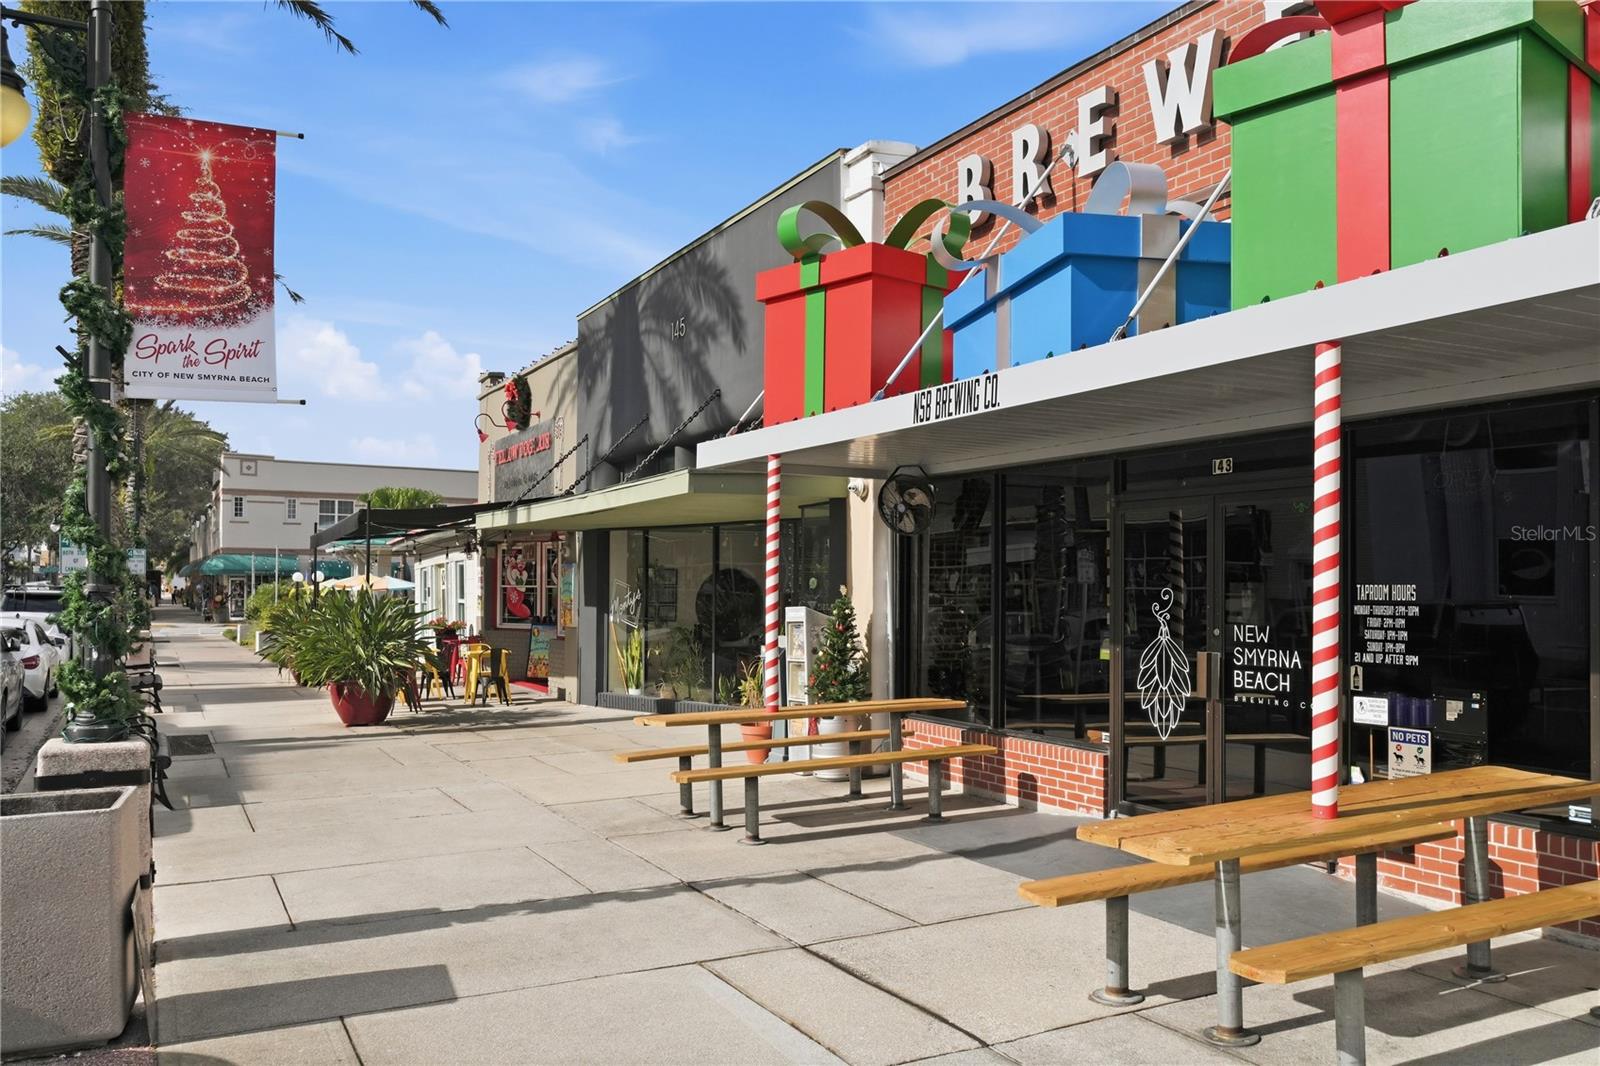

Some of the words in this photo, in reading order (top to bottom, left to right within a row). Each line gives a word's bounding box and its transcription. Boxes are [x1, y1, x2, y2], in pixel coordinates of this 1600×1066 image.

[671, 317, 686, 341] 145
[135, 333, 198, 364] Spark
[182, 354, 200, 368] the
[204, 338, 266, 369] Spirit
[132, 370, 154, 378] CITY
[173, 372, 194, 380] NEW
[197, 373, 236, 382] SMYRNA
[239, 375, 270, 383] BEACH
[912, 389, 932, 424] NSB
[935, 378, 980, 420] BREWING
[983, 373, 1000, 409] CO.
[1213, 458, 1232, 474] 143
[1356, 584, 1389, 601] TAPROOM
[1391, 584, 1417, 601] HOURS
[1233, 624, 1270, 643] NEW
[1233, 646, 1302, 670] SMYRNA
[1354, 652, 1361, 662] 21
[1362, 652, 1375, 663] AND
[1376, 654, 1384, 664] UP
[1384, 654, 1404, 665] AFTER
[1405, 655, 1419, 666] 9PM
[1233, 670, 1290, 692] BEACH
[1234, 695, 1289, 708] BREWING
[1392, 730, 1404, 741] NO
[1405, 733, 1427, 744] PETS
